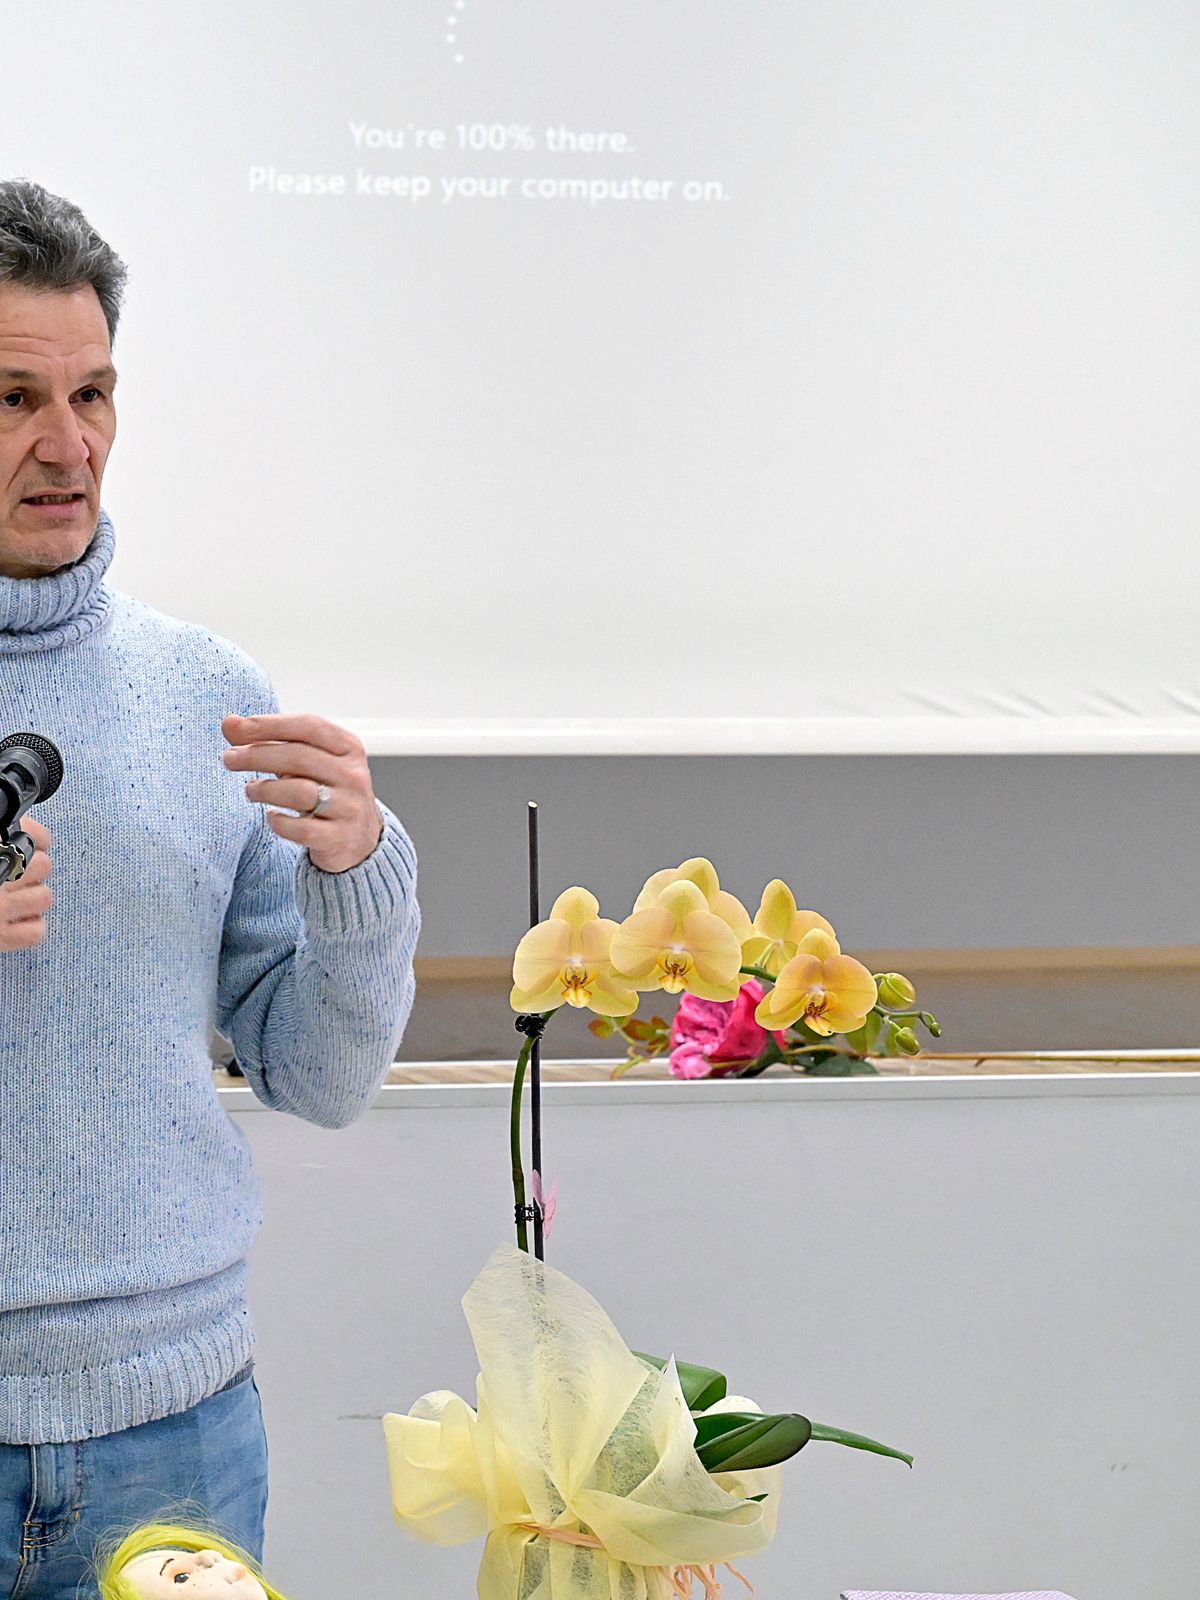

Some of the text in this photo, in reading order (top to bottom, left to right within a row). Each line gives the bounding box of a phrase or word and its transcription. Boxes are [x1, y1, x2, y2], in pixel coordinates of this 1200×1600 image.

[349, 121, 635, 153] You're 100% there.
[248, 165, 732, 207] Please keep your computer on.
